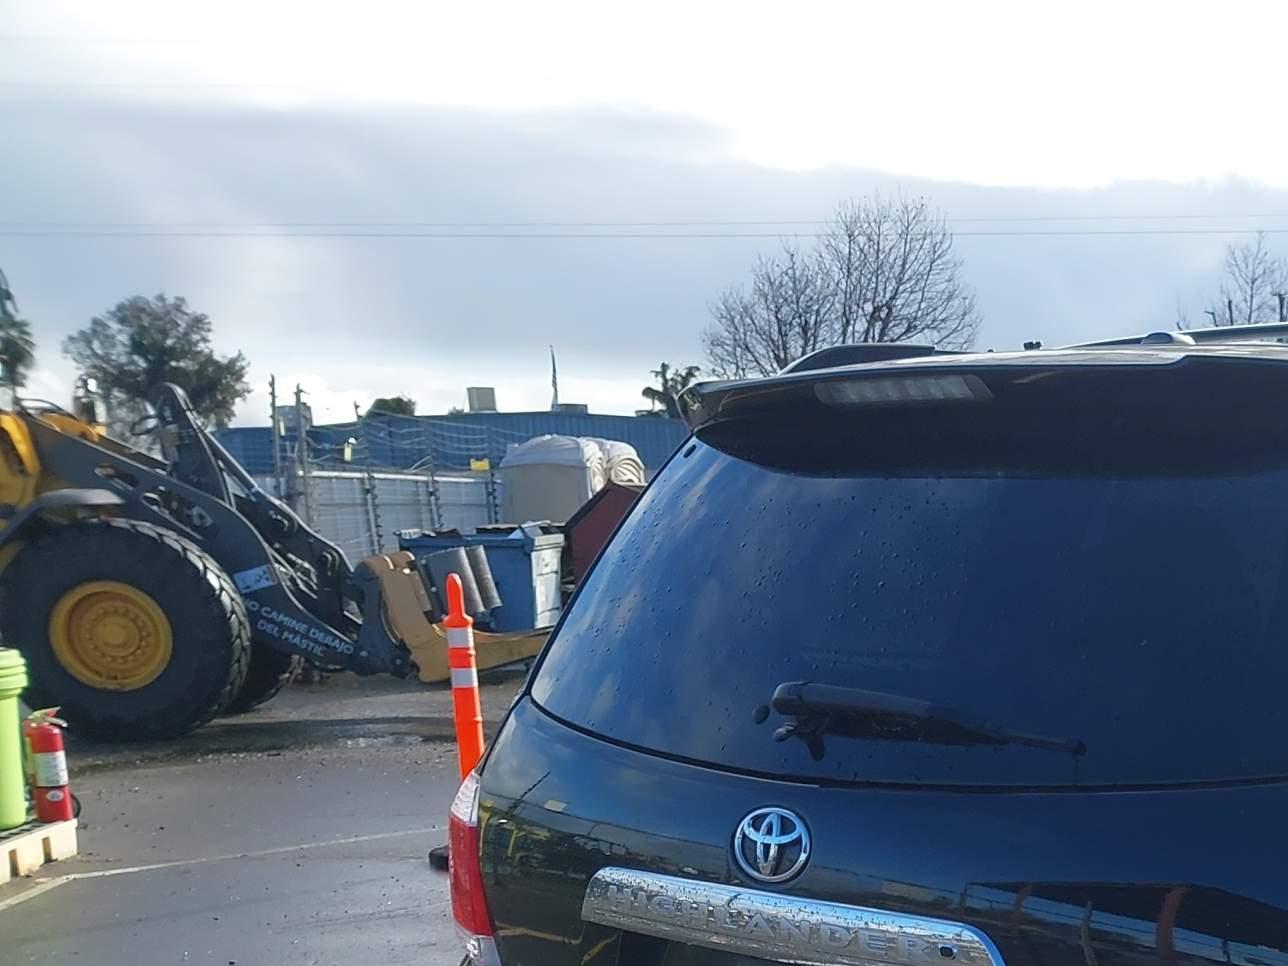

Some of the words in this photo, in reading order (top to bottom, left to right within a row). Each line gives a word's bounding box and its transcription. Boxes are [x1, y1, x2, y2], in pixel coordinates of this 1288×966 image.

[256, 619, 280, 637] DEL
[261, 606, 309, 635] CAMINE
[309, 627, 355, 655] DEBAJO
[605, 884, 937, 962] HIGHLANDER
